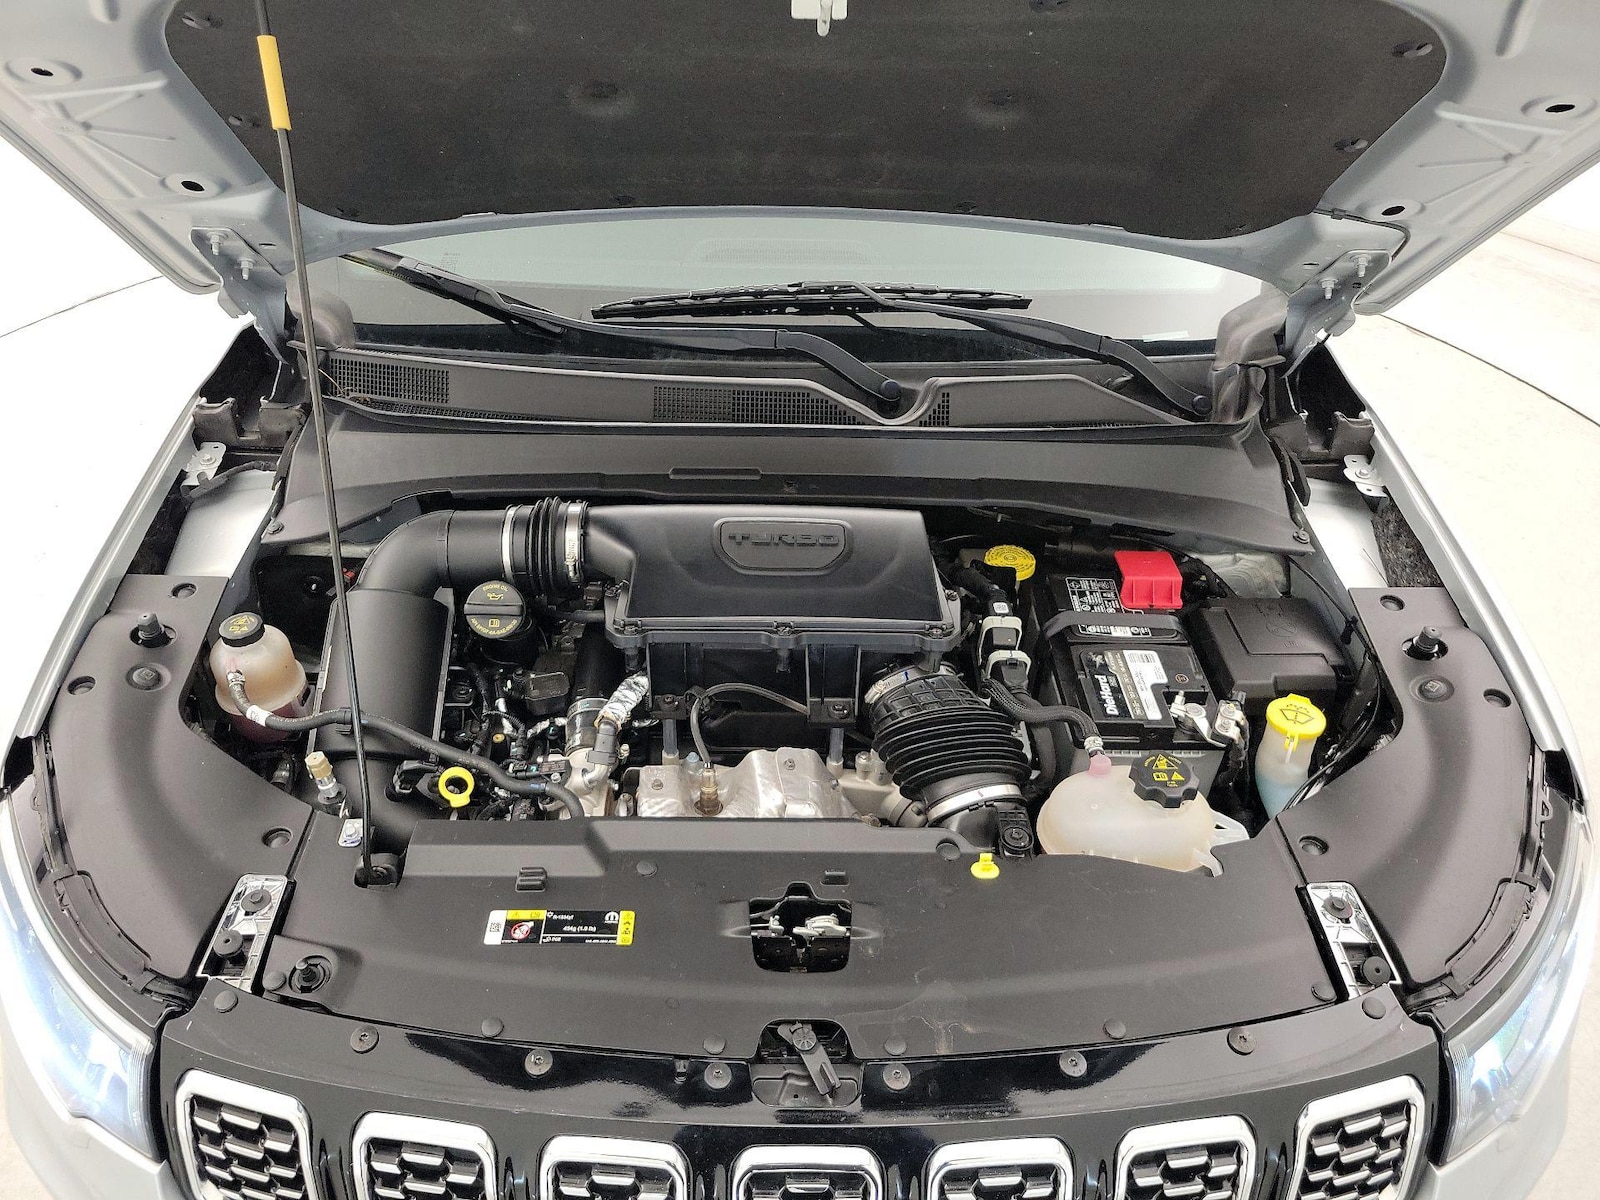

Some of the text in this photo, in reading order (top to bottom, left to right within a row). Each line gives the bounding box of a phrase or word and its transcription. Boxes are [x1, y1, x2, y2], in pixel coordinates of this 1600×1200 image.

[728, 532, 840, 547] TURBO
[482, 584, 500, 592] ENGINE
[1094, 673, 1119, 716] DieHard
